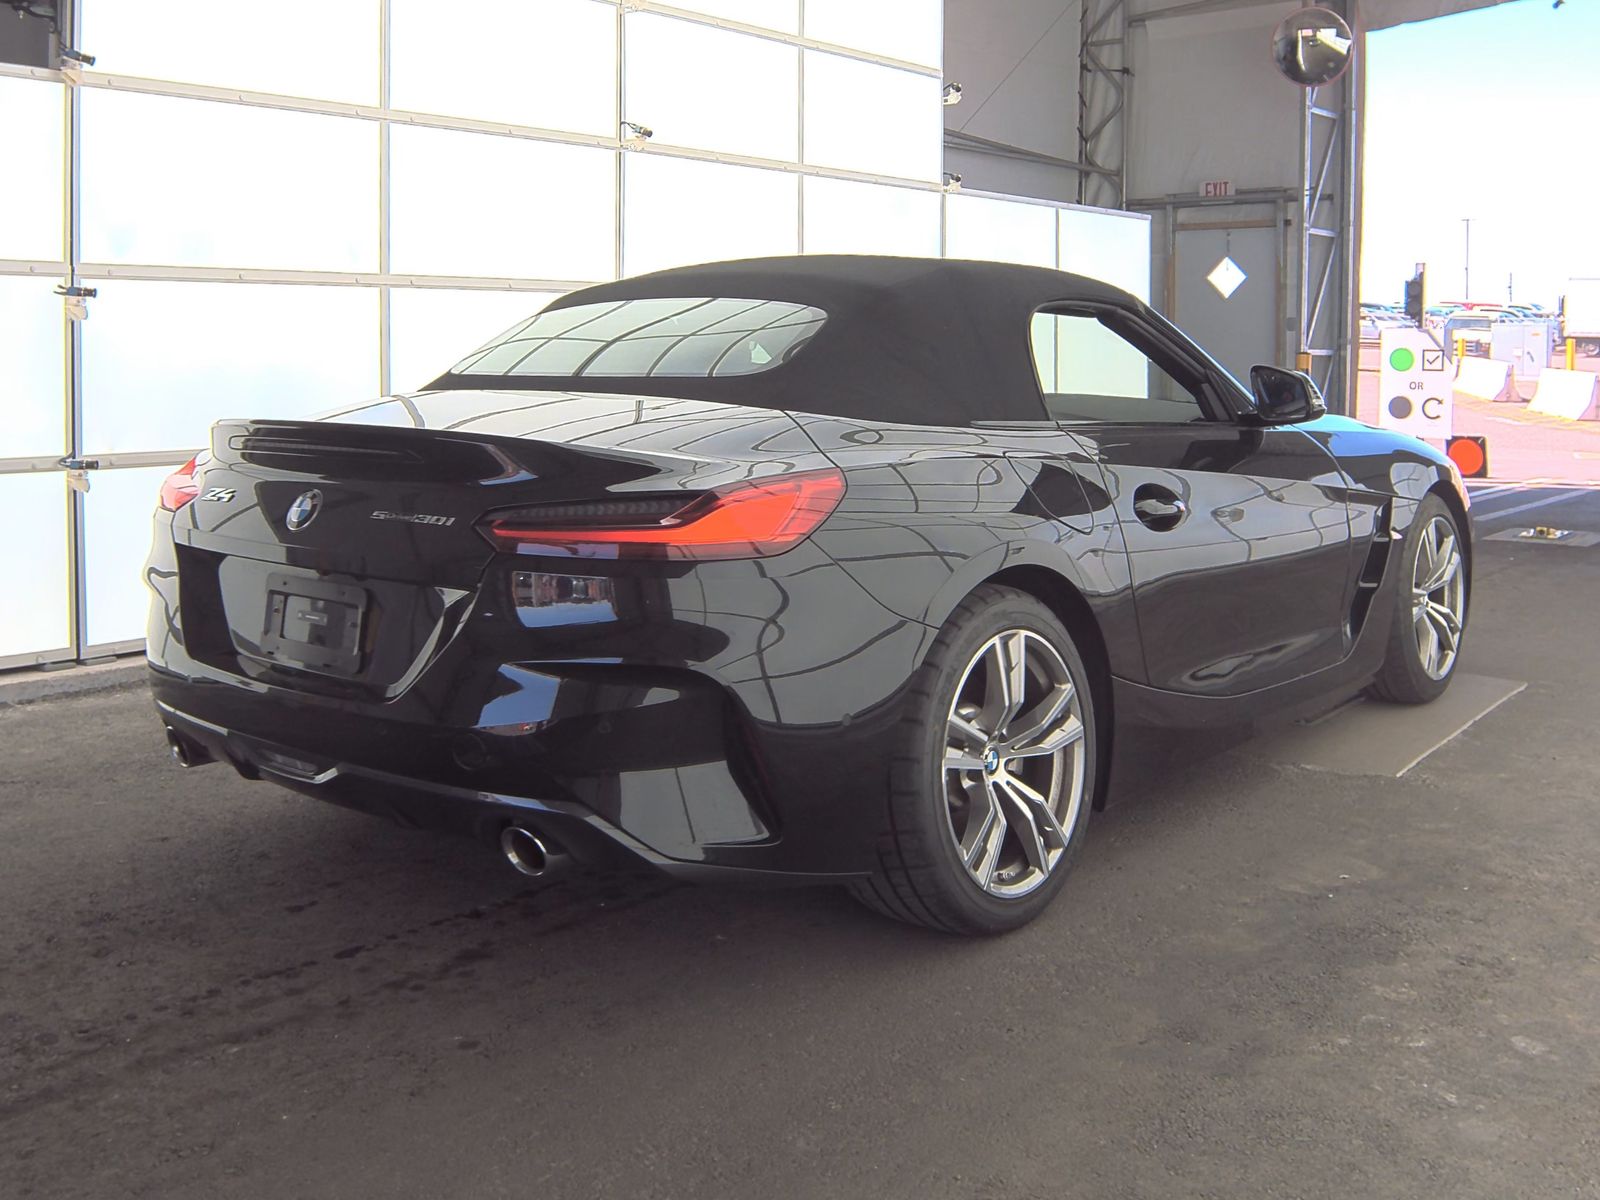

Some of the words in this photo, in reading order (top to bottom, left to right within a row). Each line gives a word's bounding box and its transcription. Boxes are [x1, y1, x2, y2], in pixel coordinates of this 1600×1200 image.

[1205, 181, 1229, 197] EXIT
[1409, 381, 1424, 390] OR
[201, 487, 236, 502] Z4
